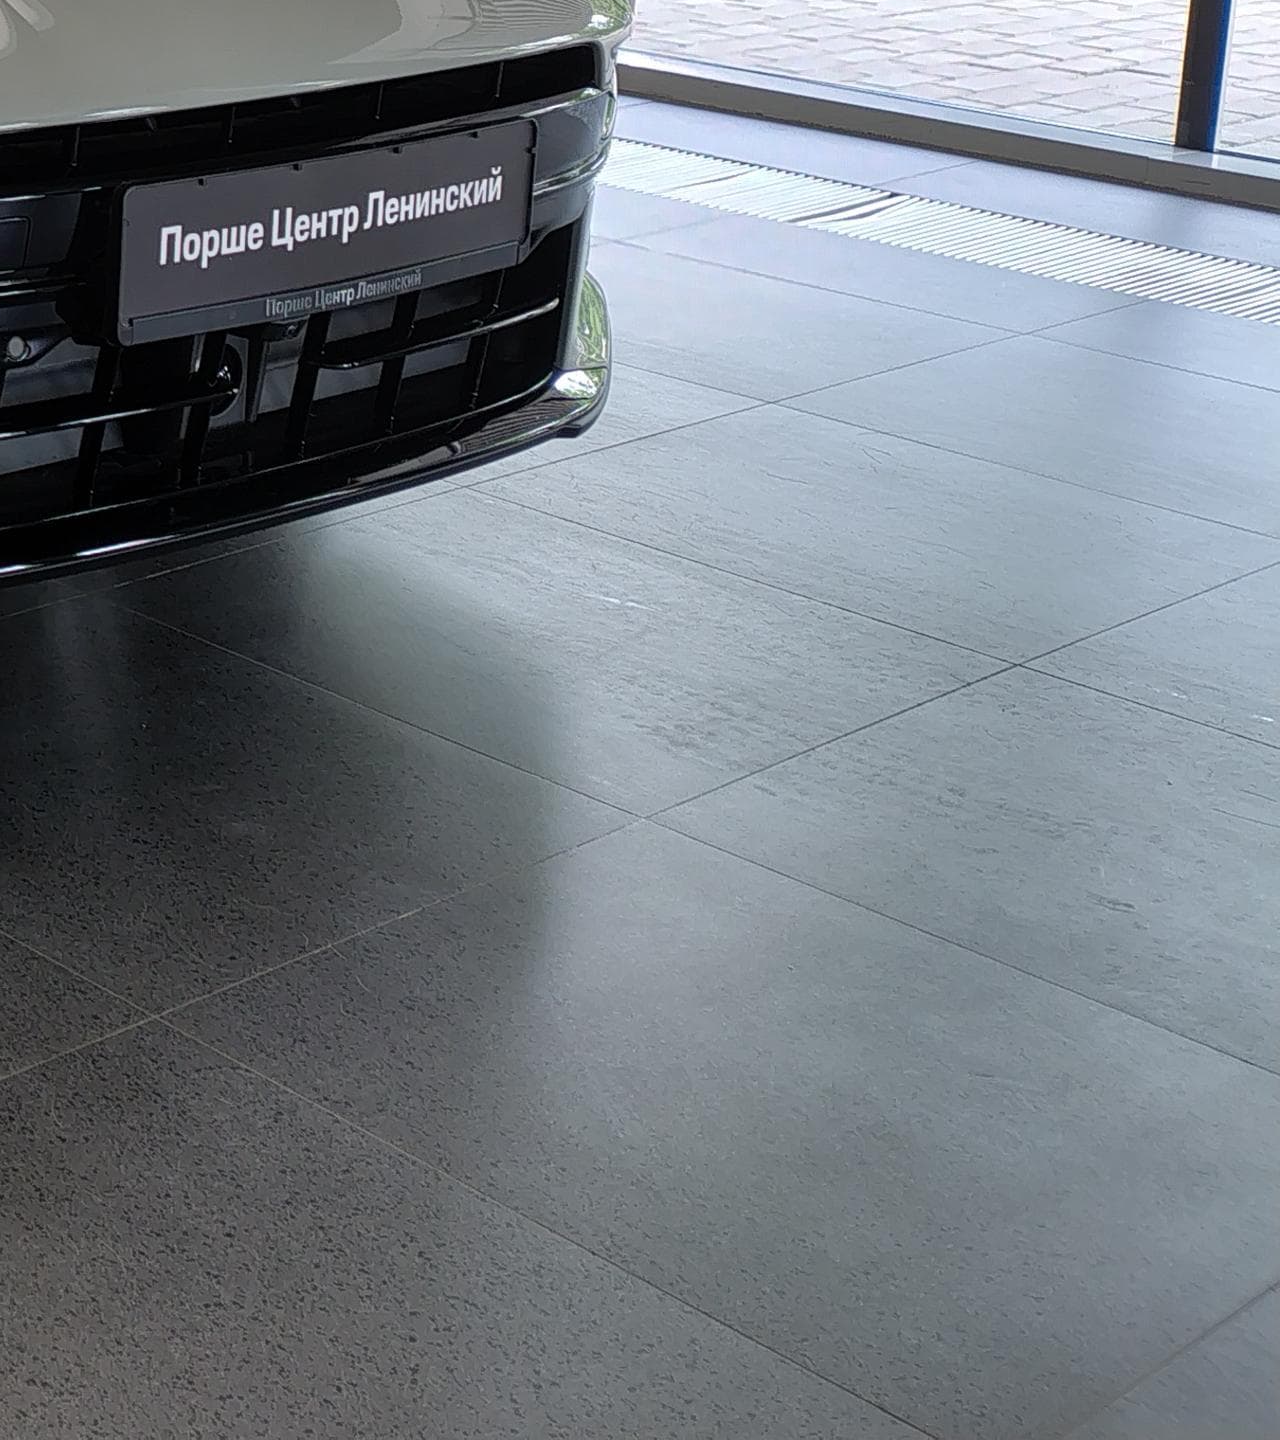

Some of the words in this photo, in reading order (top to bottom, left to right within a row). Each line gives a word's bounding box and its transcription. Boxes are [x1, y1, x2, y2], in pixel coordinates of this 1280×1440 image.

[159, 222, 265, 269] Порше
[271, 205, 359, 252] Центр
[362, 166, 504, 230] Ленинский
[265, 298, 312, 318] Порше
[314, 288, 355, 309] Центр
[356, 269, 422, 299] Ленинский
